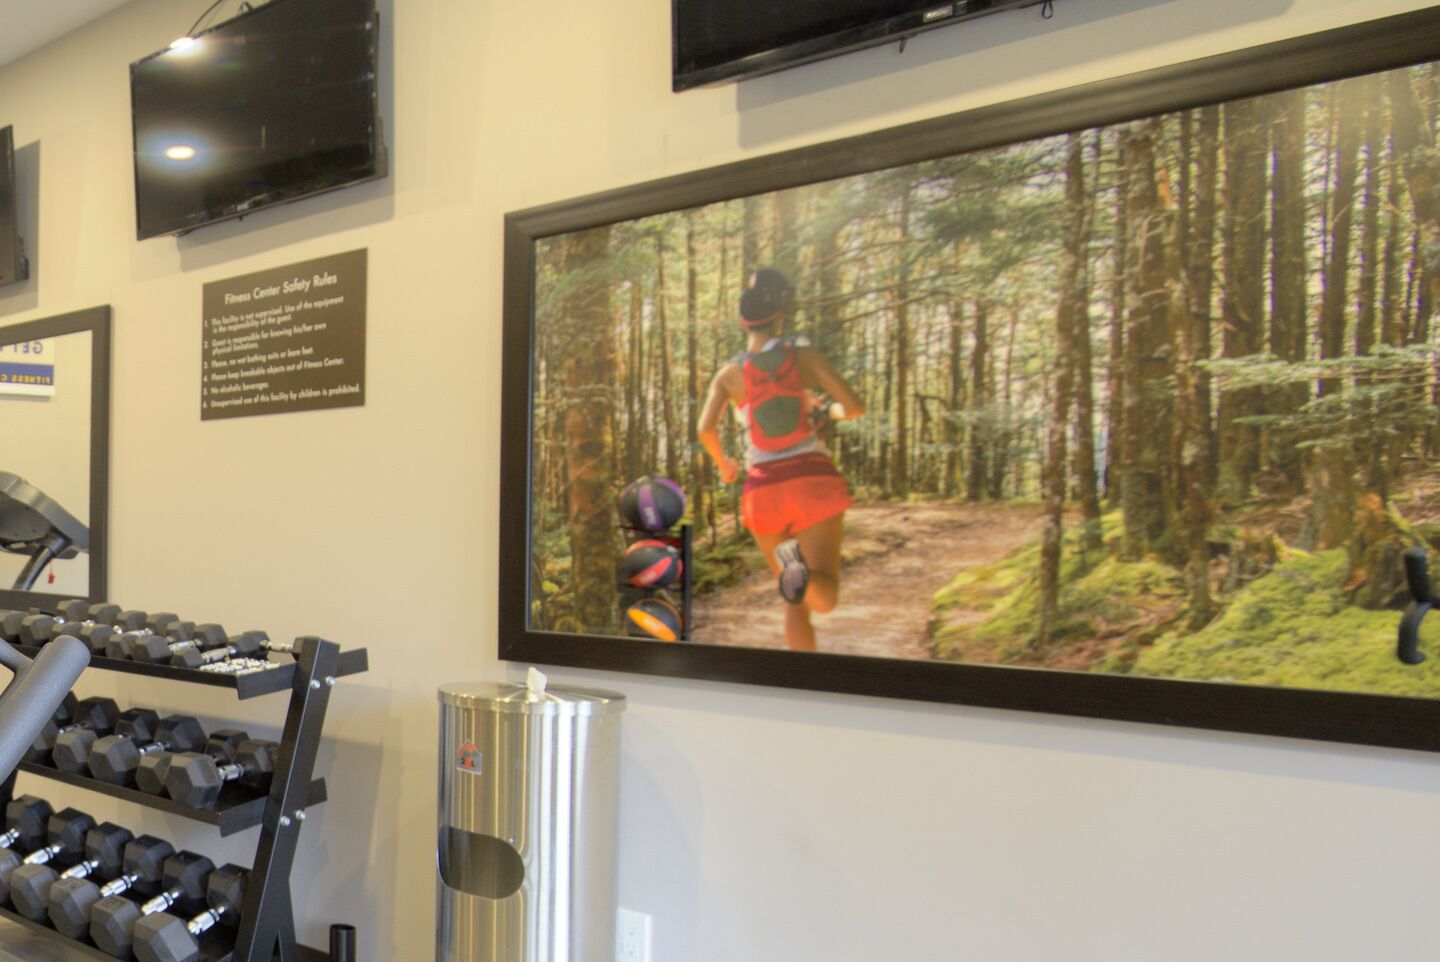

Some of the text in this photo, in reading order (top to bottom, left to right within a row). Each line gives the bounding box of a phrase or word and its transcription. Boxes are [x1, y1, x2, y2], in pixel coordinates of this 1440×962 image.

[224, 272, 338, 305] Fitness Center Safety Rules
[314, 296, 344, 309] equipment
[240, 367, 266, 378] breakable
[298, 387, 320, 399] children
